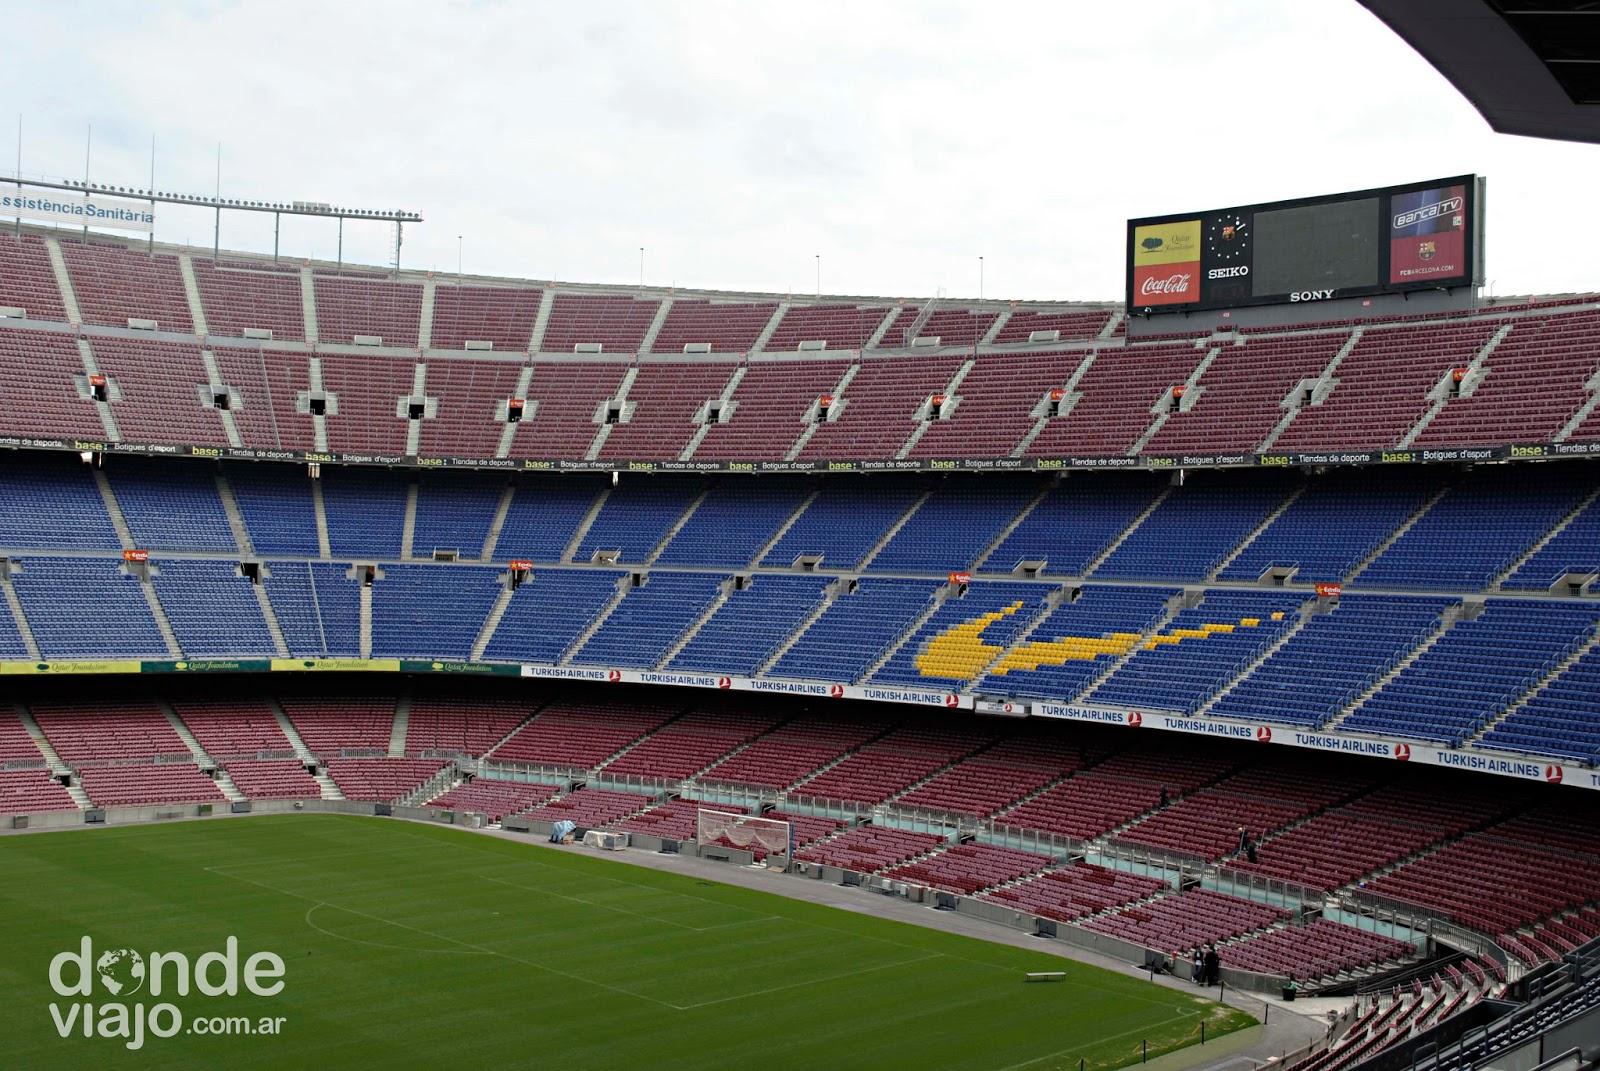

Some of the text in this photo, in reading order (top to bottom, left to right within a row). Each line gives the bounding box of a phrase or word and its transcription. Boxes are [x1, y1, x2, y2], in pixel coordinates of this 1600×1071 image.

[0, 196, 154, 223] ssistència Sanitària
[1442, 200, 1459, 212] TV
[1208, 266, 1248, 279] SEIKO
[1290, 290, 1334, 302] SONY
[114, 443, 146, 452] Botigues
[228, 449, 254, 457] Tiendas
[1554, 444, 1587, 453] Tiendas
[342, 454, 372, 462] Botigues
[1183, 456, 1214, 466] Botigues
[1298, 454, 1328, 463] Tiendas
[1329, 454, 1339, 462] de
[1341, 453, 1370, 464] deporte
[1423, 450, 1457, 461] Botigues
[489, 459, 514, 468] deporte
[695, 462, 720, 470] deporte
[896, 460, 920, 470] deporte
[965, 460, 993, 468] Botigues
[1071, 458, 1096, 466] Tiendas
[1108, 458, 1135, 466] deporte
[531, 667, 604, 679] TURKISH AIRLINES
[640, 674, 714, 686] TURKISH AIRLINES
[751, 681, 826, 694] TURKISH AIRLINES
[864, 689, 942, 704] TURKISH AIRLINES
[1042, 706, 1123, 722] TURKISH AIRLINES
[1164, 718, 1252, 738] TURKISH AIRLINES
[1296, 734, 1389, 756] TURKISH AIRLINES
[1438, 752, 1540, 777] TURKISH AIRLINES
